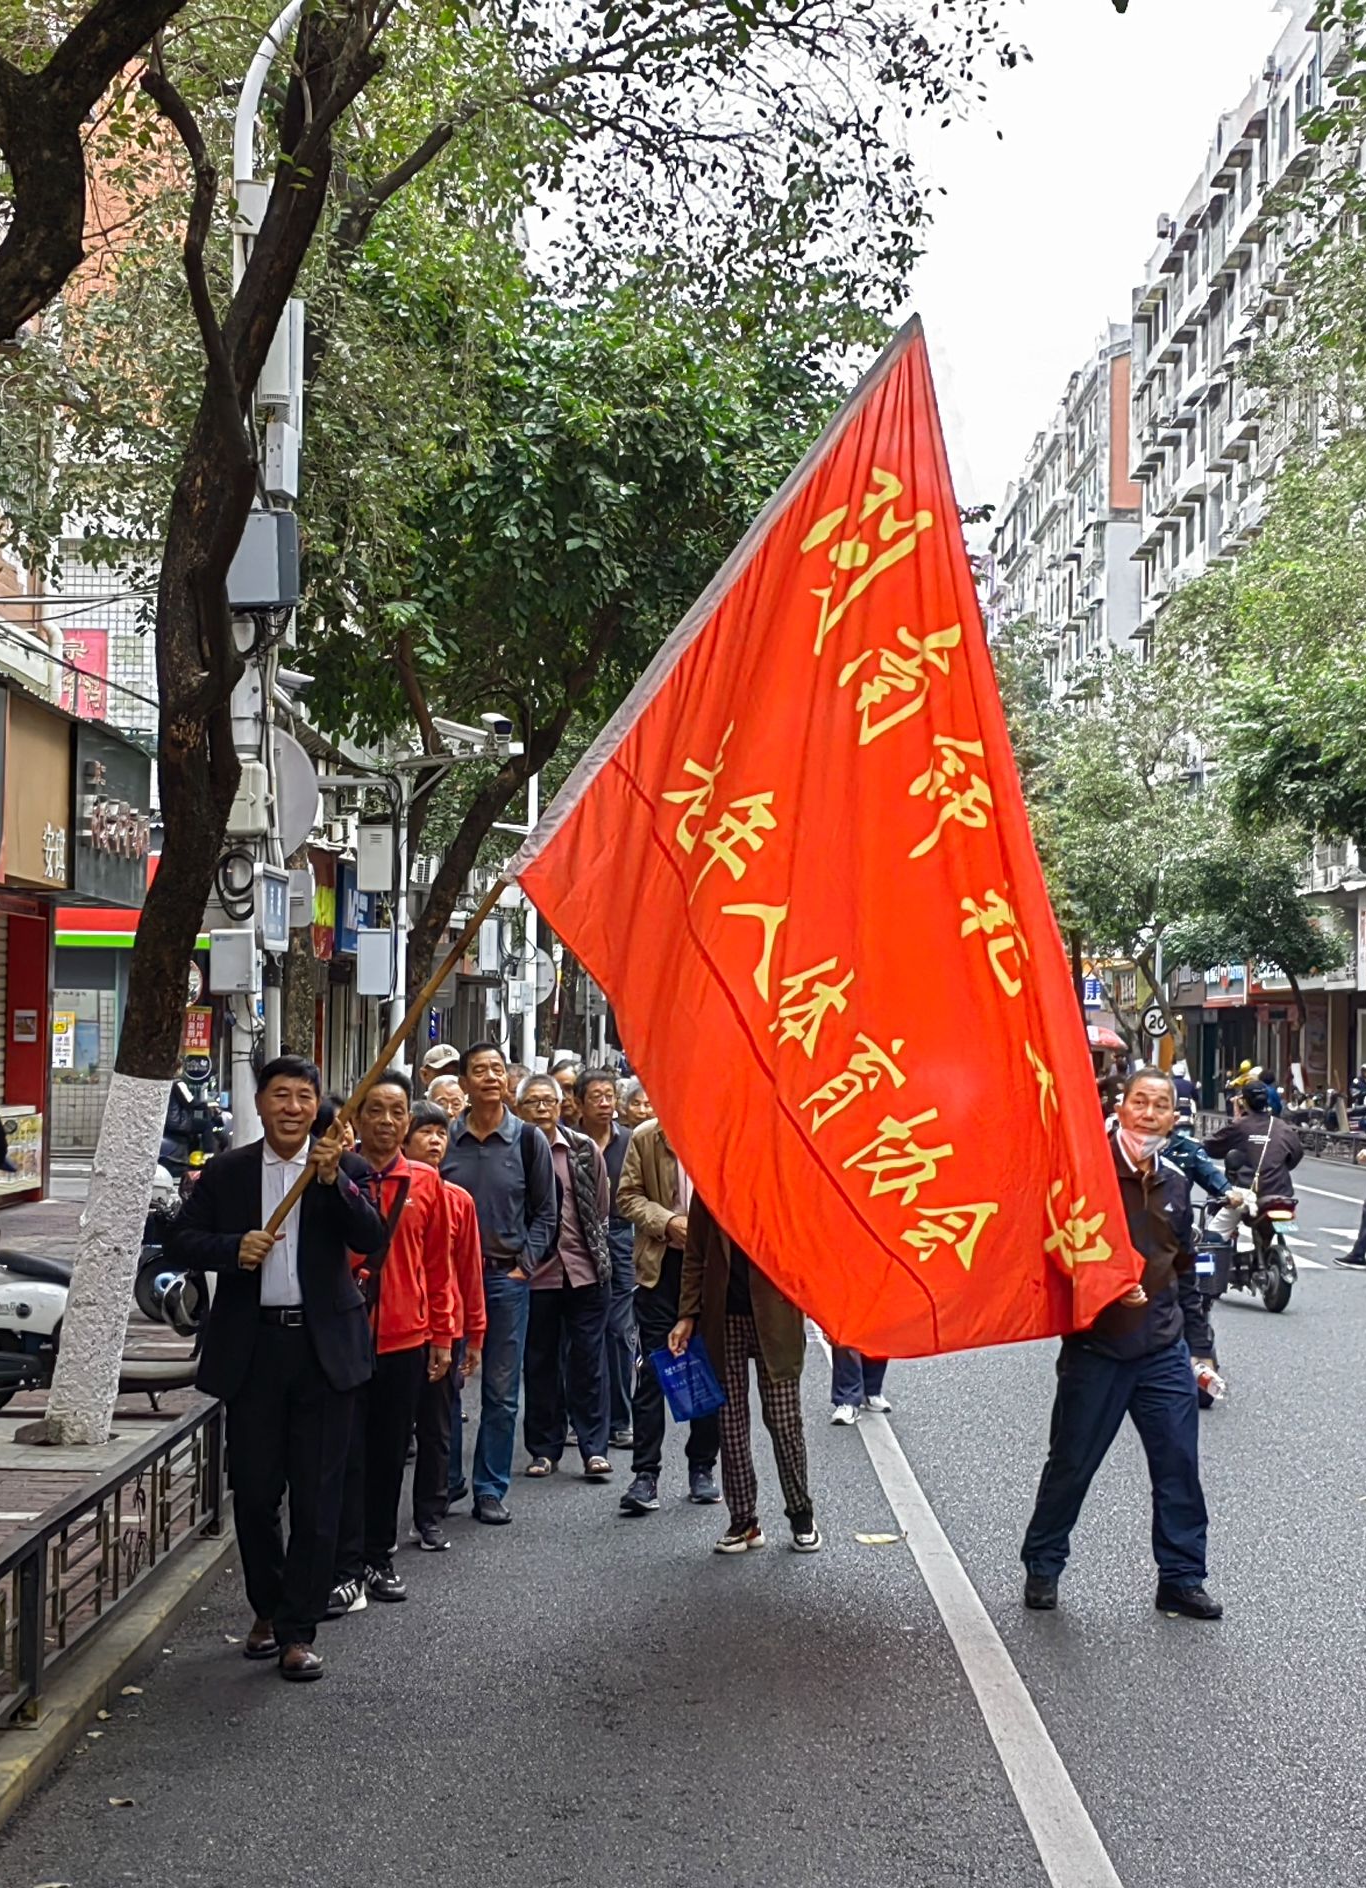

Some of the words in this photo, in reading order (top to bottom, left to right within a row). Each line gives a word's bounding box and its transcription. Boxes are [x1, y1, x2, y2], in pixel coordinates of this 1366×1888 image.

[662, 721, 998, 1270] 老年人体育协会
